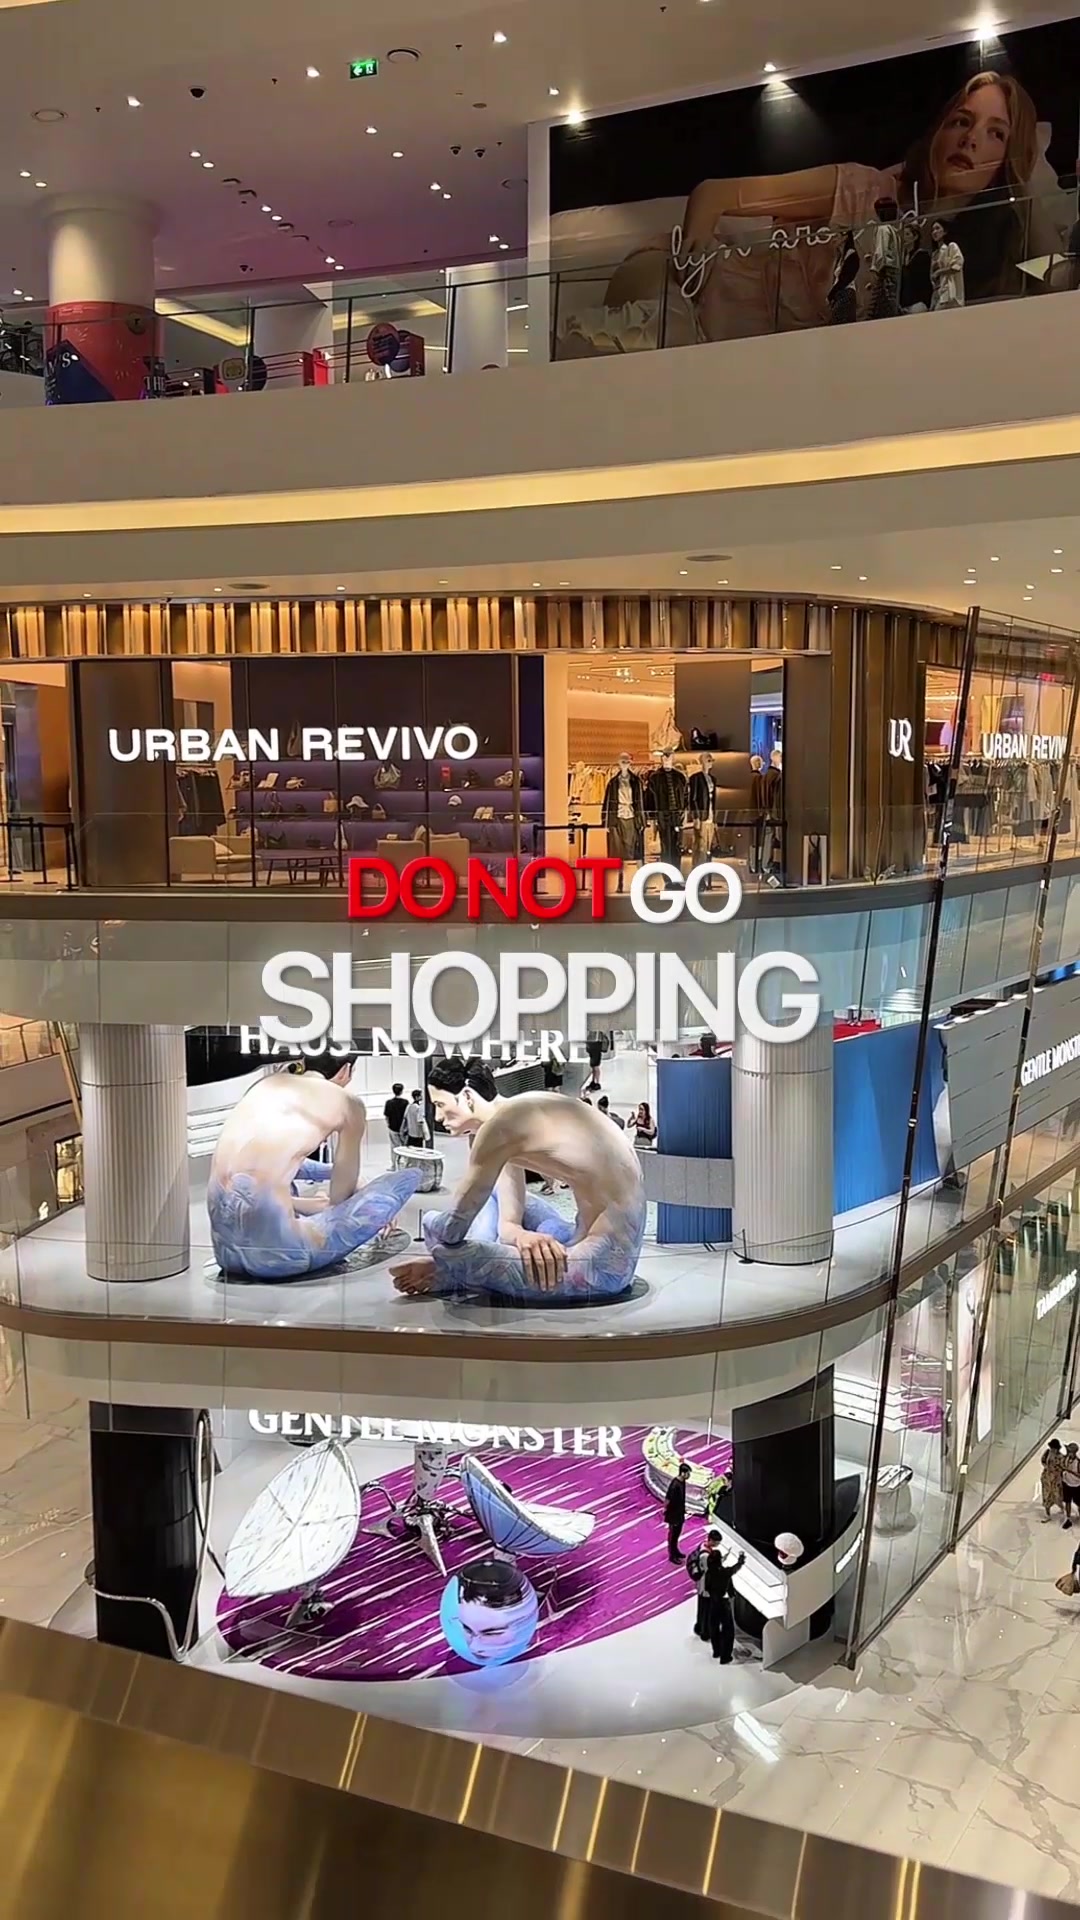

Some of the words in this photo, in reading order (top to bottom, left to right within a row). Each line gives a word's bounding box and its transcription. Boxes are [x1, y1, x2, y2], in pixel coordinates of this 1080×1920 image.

[769, 181, 927, 249] arod
[108, 728, 279, 761] URBAN
[301, 726, 479, 760] REVIVO
[889, 717, 915, 761] UR
[982, 732, 1028, 760] URBAN
[1031, 734, 1068, 760] REVIV
[1020, 1049, 1053, 1087] GENTLE
[248, 1408, 405, 1442] GENTLE
[416, 1411, 625, 1459] MONSTER
